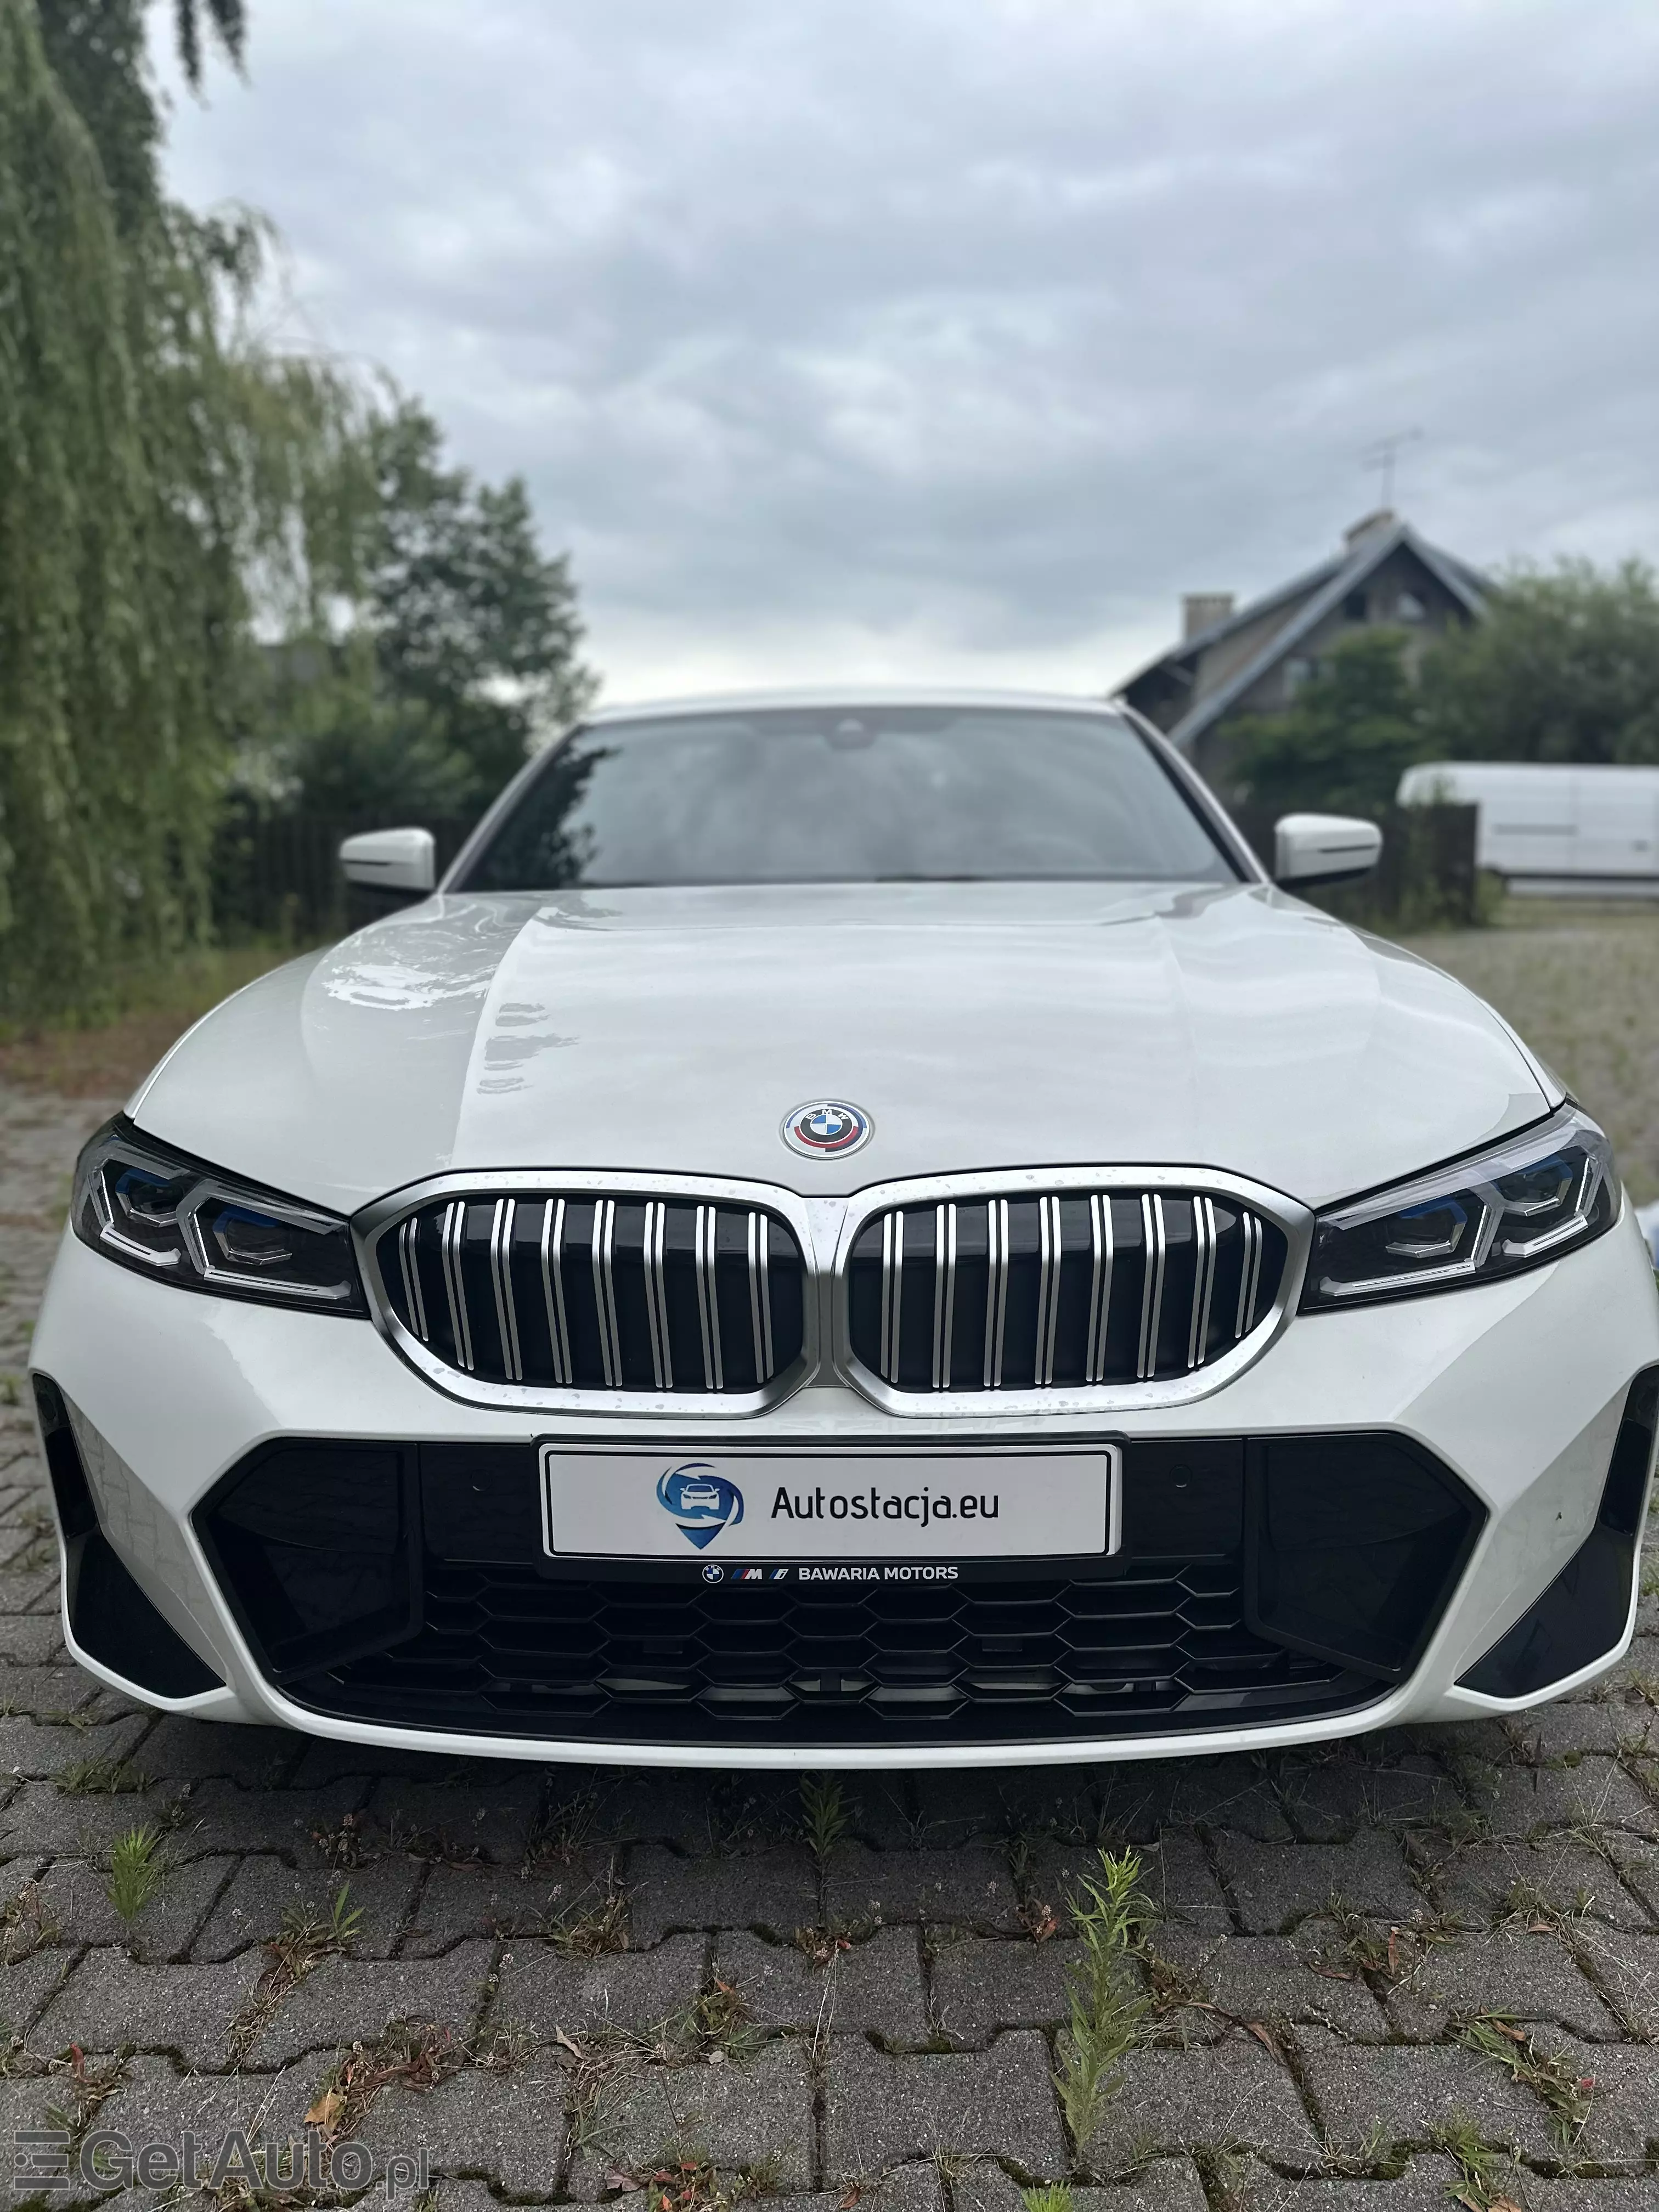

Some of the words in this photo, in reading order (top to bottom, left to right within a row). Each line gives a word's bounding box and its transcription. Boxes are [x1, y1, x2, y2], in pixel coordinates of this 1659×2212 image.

[805, 1109, 849, 1120] BMW
[771, 1487, 998, 1527] Autostacja.eu
[799, 1567, 879, 1580] BAWARIA
[884, 1566, 958, 1579] MOTORS
